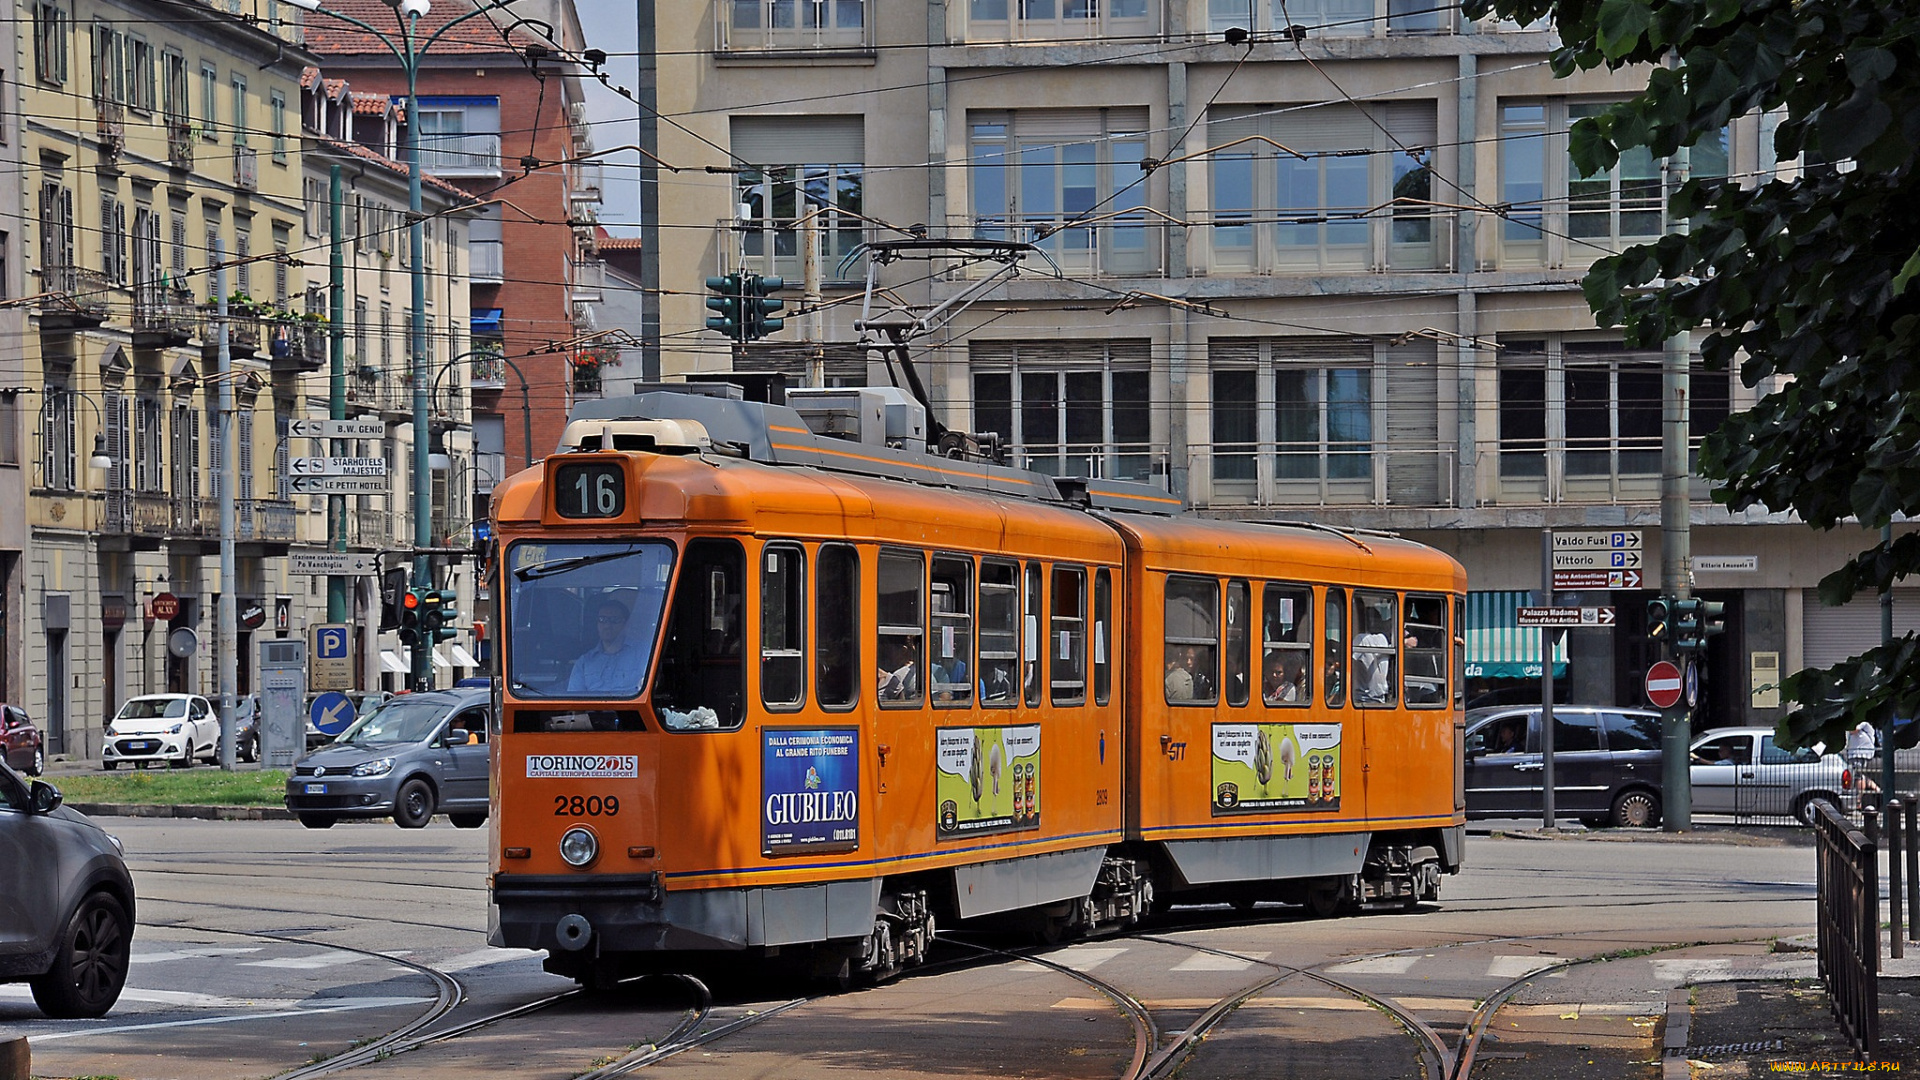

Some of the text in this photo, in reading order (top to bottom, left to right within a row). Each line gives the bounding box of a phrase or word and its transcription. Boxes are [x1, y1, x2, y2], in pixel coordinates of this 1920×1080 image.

[337, 425, 383, 433] B.W. GENIO
[333, 458, 382, 466] STARHOTELS
[343, 467, 383, 475] MAJESTIC
[576, 473, 616, 514] 16
[1555, 537, 1584, 545] Valdo
[1587, 536, 1608, 545] Fusi
[1555, 556, 1594, 564] Vittorio
[324, 635, 340, 656] P
[768, 736, 853, 746] DALLA CERIMONIA ECONOMICA
[776, 747, 848, 757] AL GRANDE RITO FUNEBRE
[554, 795, 619, 816] 2809
[766, 790, 856, 825] GIUBILEO
